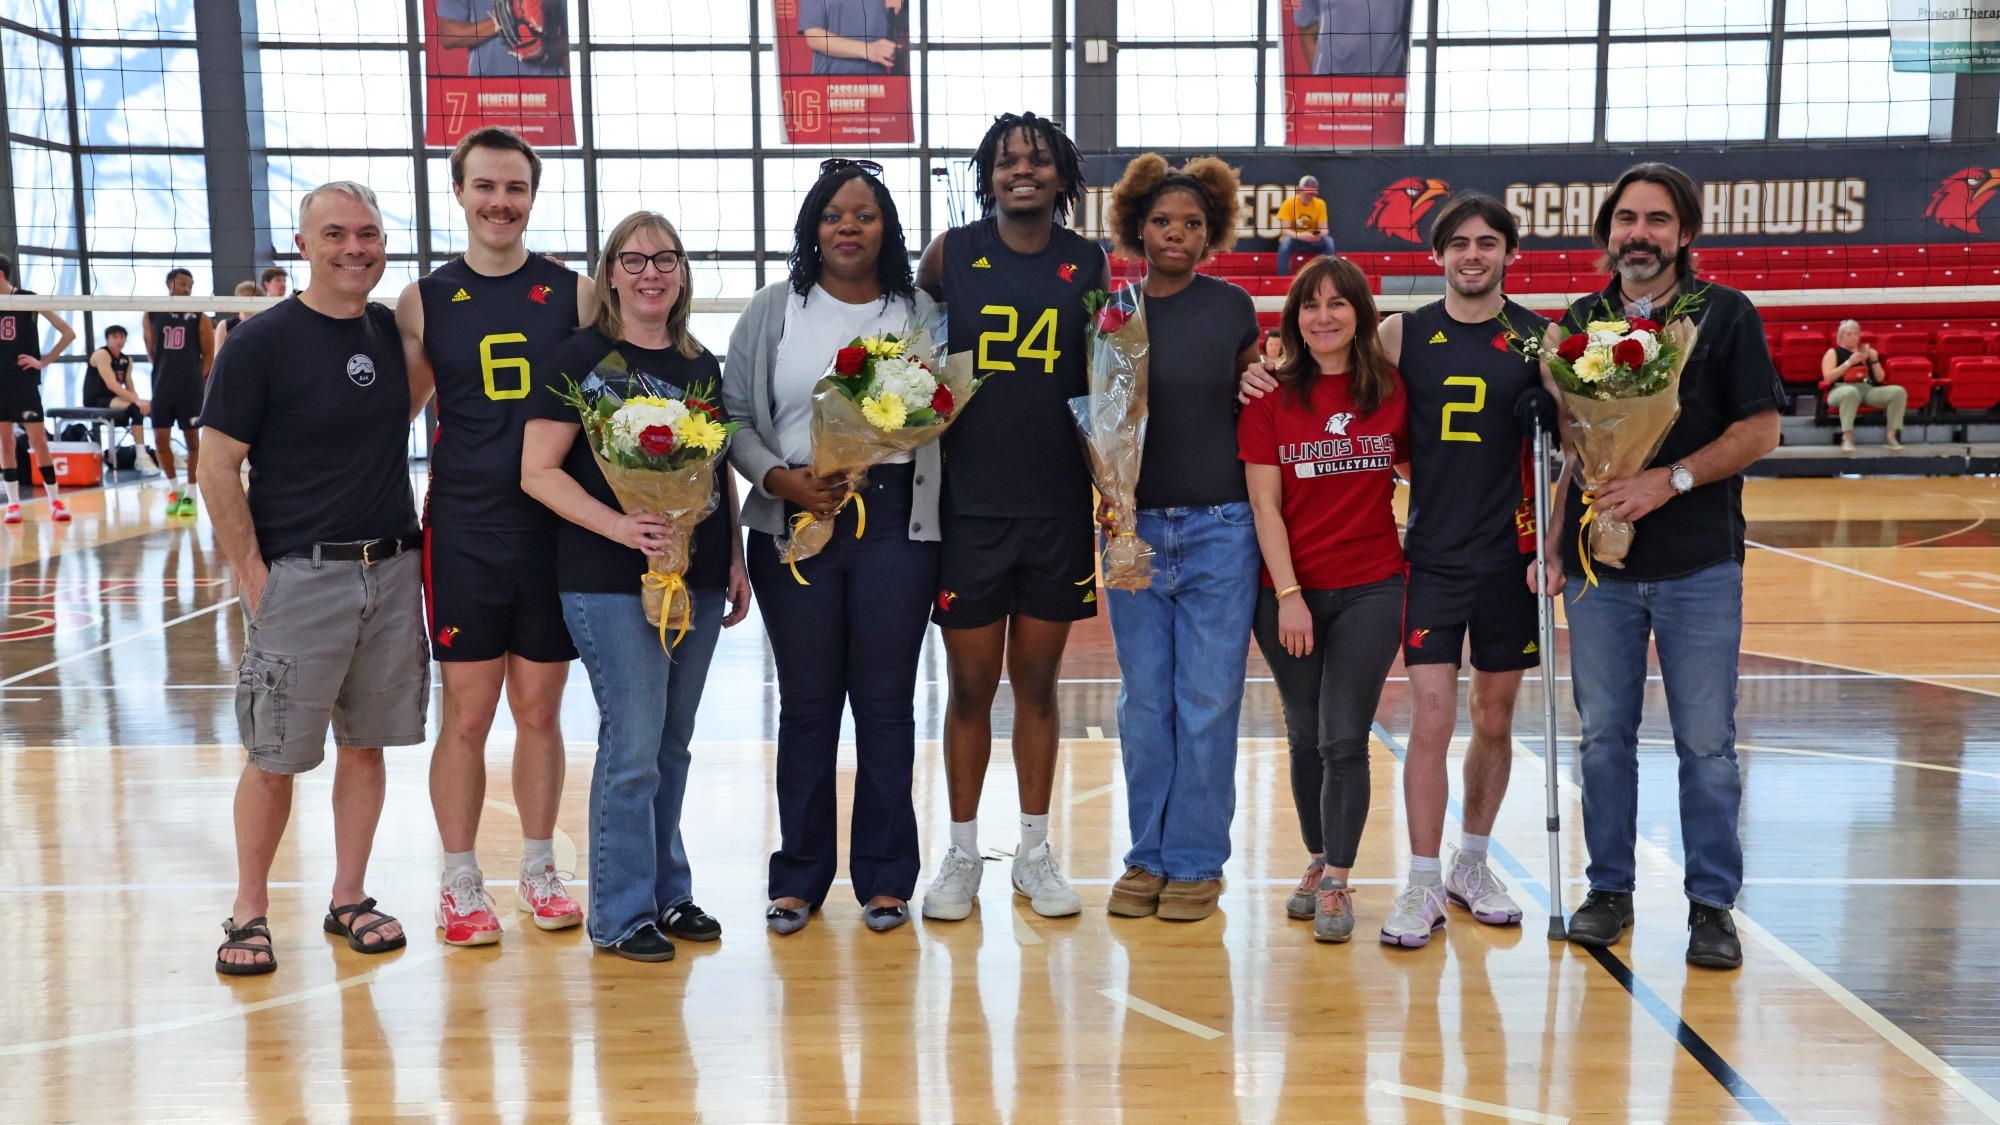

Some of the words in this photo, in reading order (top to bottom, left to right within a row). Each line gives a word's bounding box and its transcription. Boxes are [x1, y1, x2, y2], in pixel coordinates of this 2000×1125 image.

[1918, 7, 1959, 19] Physical
[446, 92, 468, 134] 7
[783, 90, 821, 133] 16
[1702, 177, 1866, 236] HAWKS
[163, 326, 186, 350] 10
[978, 305, 1062, 374] 24
[479, 332, 531, 401] 6
[1440, 376, 1487, 443] 2
[53, 457, 69, 476] G
[1316, 457, 1389, 473] VOLLEYBALL
